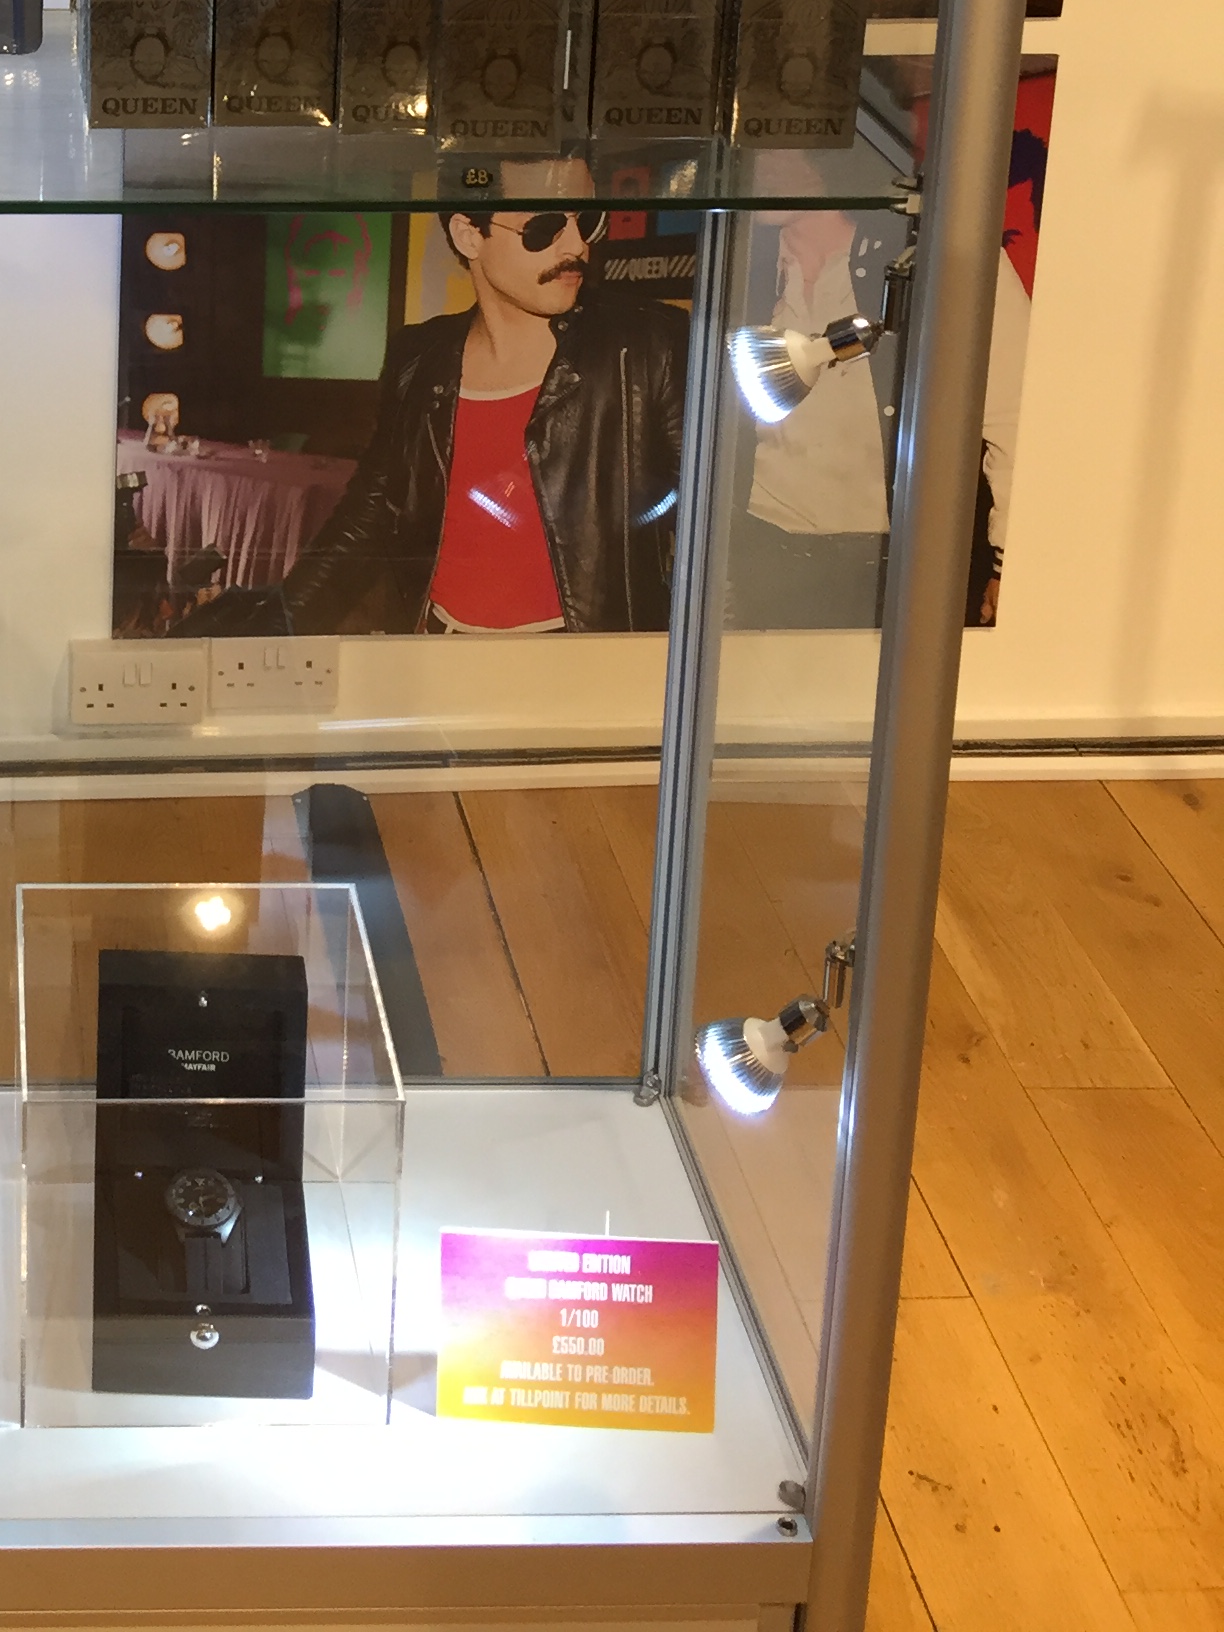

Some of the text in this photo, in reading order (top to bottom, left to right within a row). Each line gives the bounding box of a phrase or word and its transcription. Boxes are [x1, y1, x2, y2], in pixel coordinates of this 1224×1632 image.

[101, 96, 198, 116] QUEEN
[226, 94, 322, 114] QUEEN
[604, 106, 704, 127] QUEEN
[450, 118, 549, 139] QUEEN
[743, 117, 845, 137] QUEEN
[465, 169, 488, 185] £8
[582, 1253, 631, 1275] EDITION
[611, 1283, 653, 1303] WATCH
[560, 1308, 599, 1328] 1/100
[552, 1336, 605, 1356] £550.00
[566, 1364, 582, 1382] TO
[585, 1365, 655, 1386] PRE-ORDER.
[509, 1388, 570, 1409] TILLPOINT
[575, 1391, 597, 1410] FOR
[601, 1392, 636, 1413] MORE
[639, 1395, 691, 1416] DETAILS.
